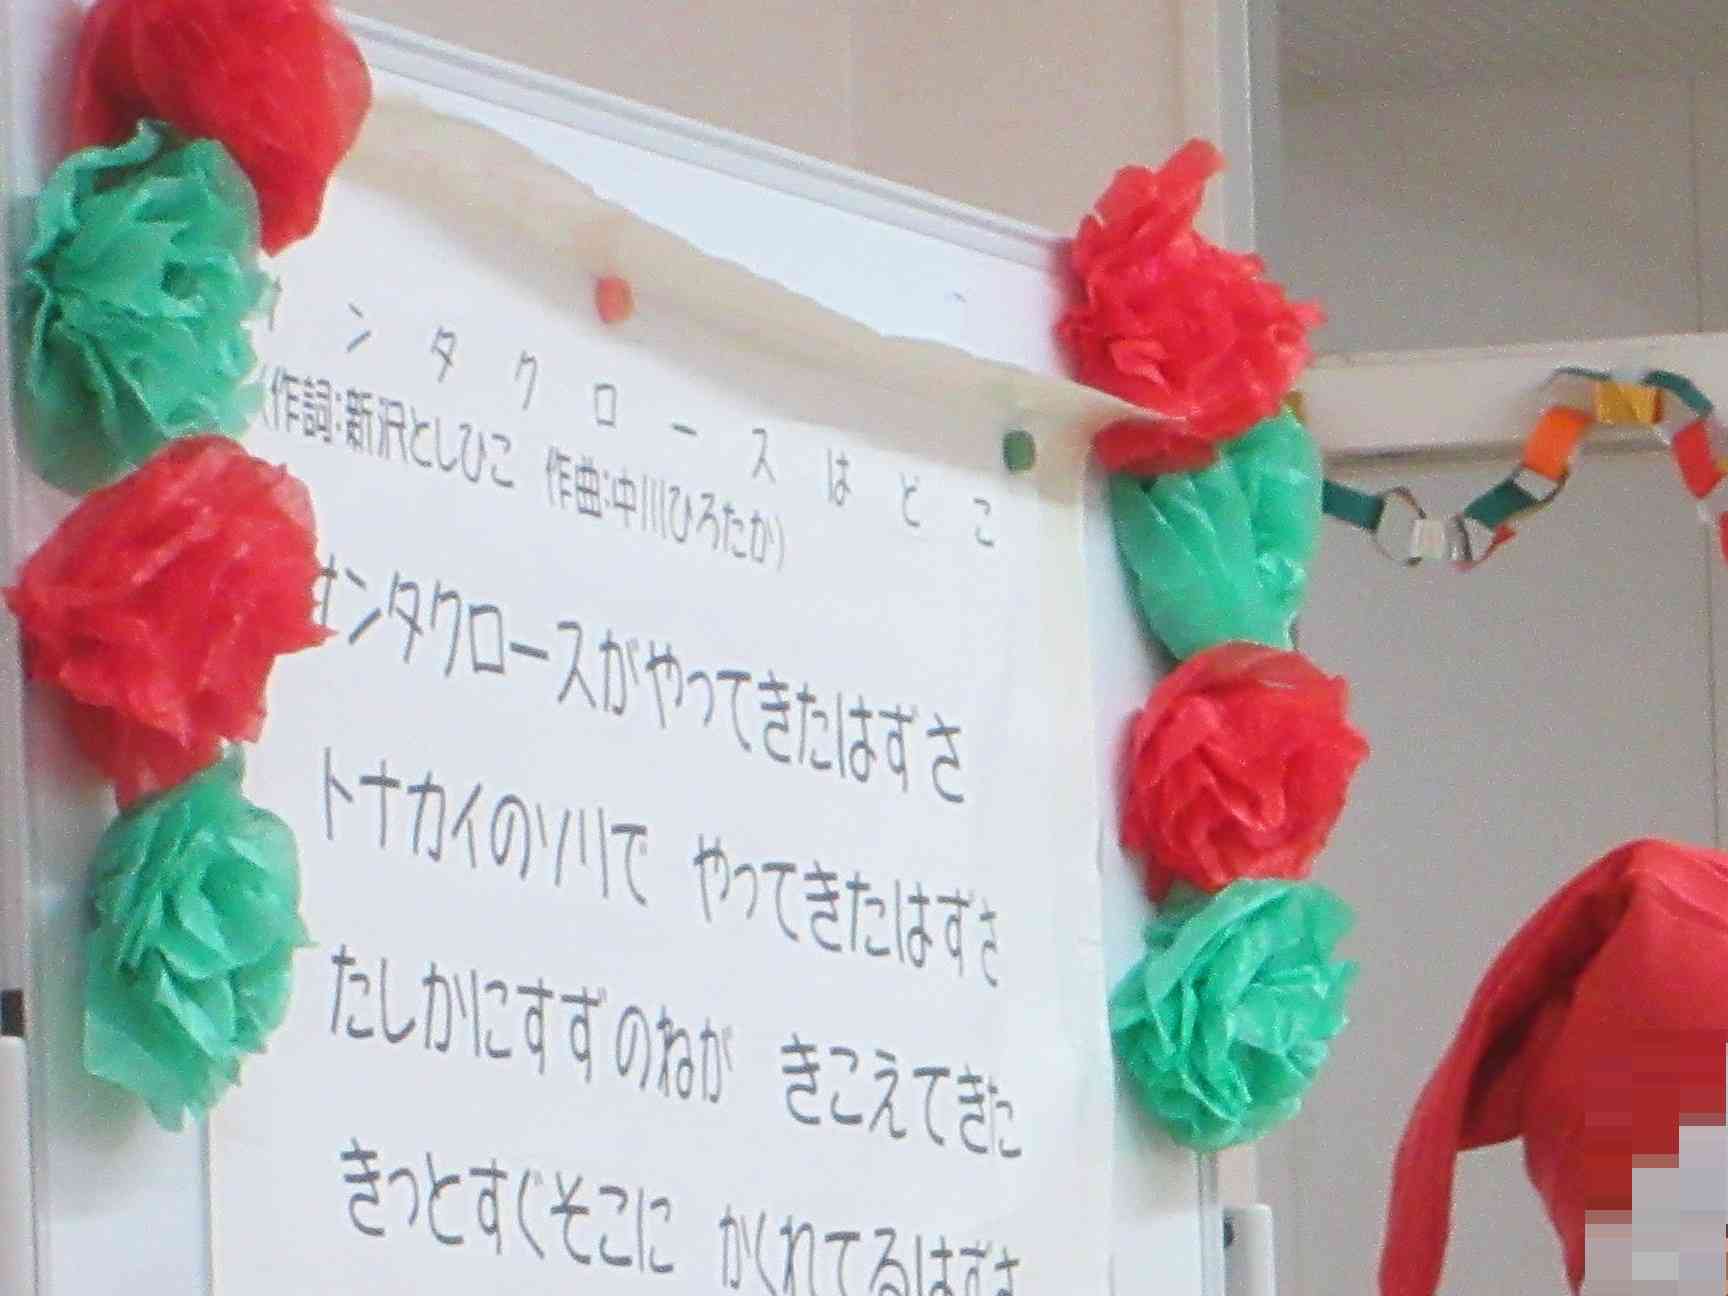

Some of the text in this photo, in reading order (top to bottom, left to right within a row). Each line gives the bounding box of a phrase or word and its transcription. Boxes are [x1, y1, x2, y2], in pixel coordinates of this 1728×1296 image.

[692, 832, 1000, 989] やってきたはずさ
[779, 1031, 1023, 1160] きこえてきた
[340, 1136, 676, 1275] きっとすぐそこに
